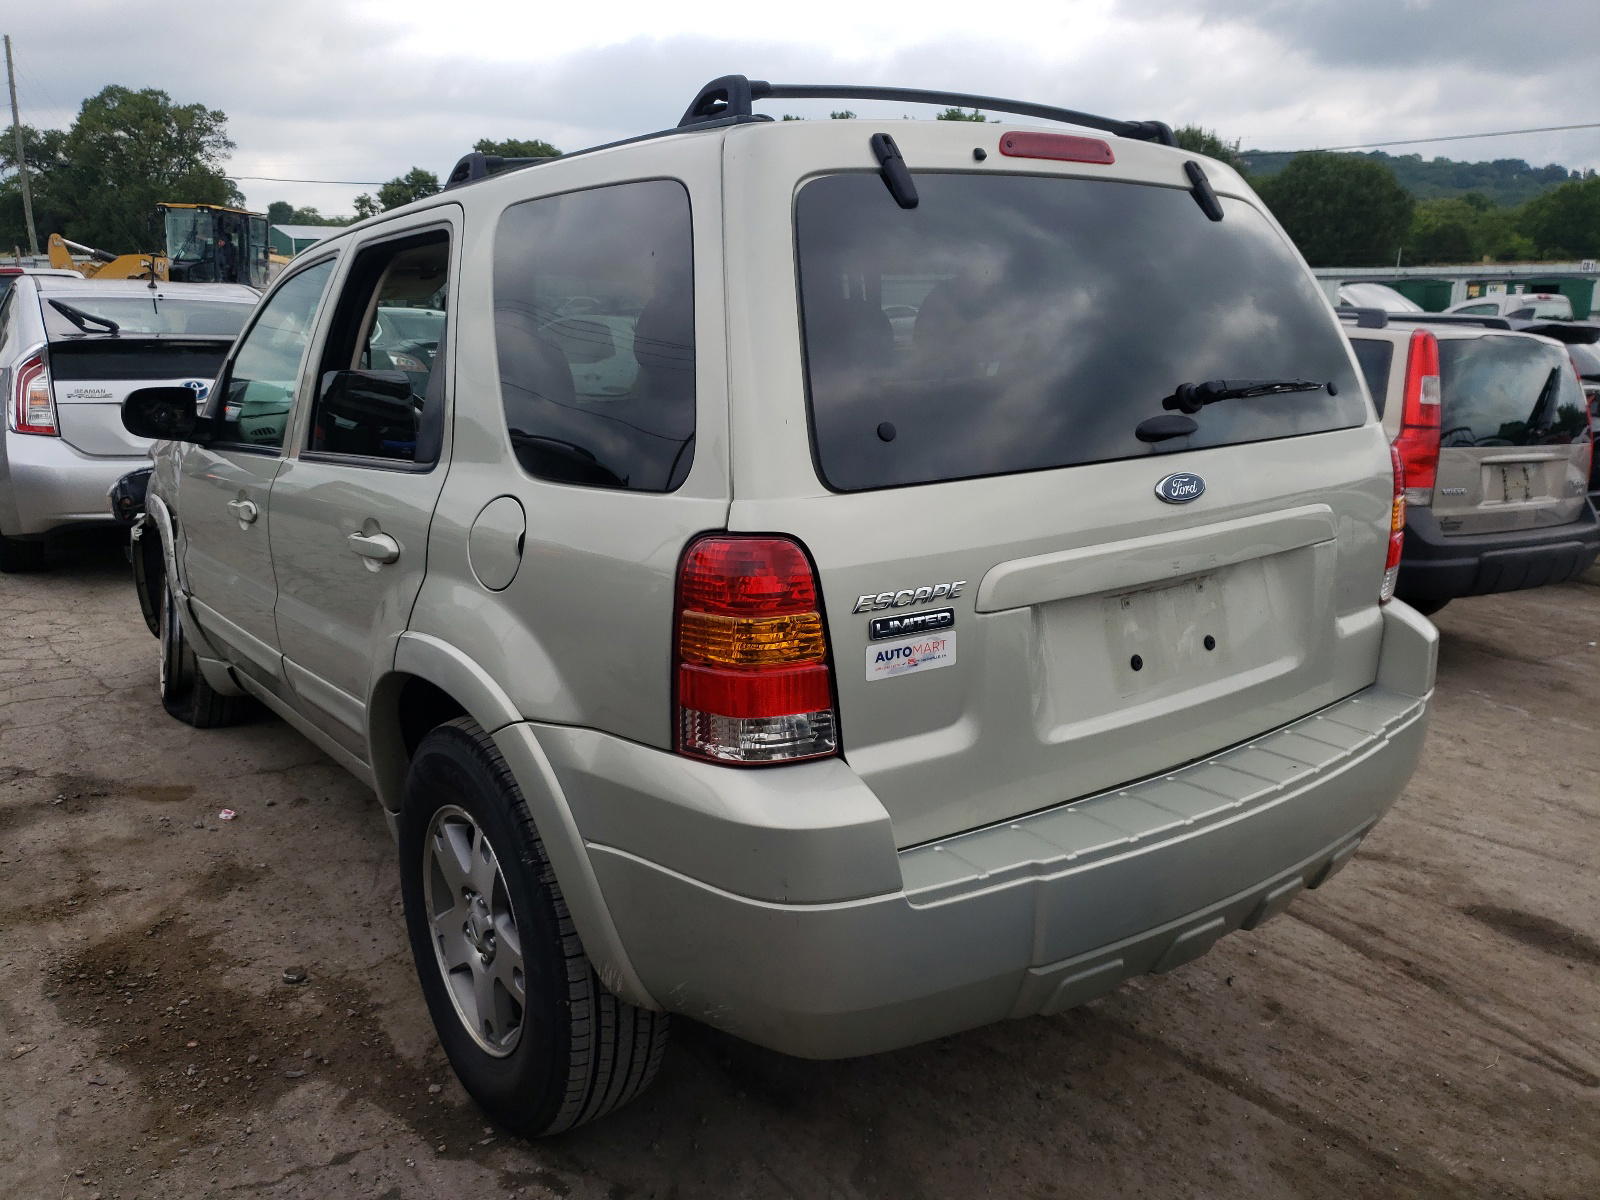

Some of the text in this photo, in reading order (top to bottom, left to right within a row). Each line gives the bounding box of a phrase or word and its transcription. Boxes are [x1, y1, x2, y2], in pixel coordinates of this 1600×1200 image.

[1171, 477, 1198, 497] Ford
[852, 580, 967, 614] ESCAPE
[876, 612, 951, 634] LIMITED
[875, 639, 948, 663] AUTOMART
